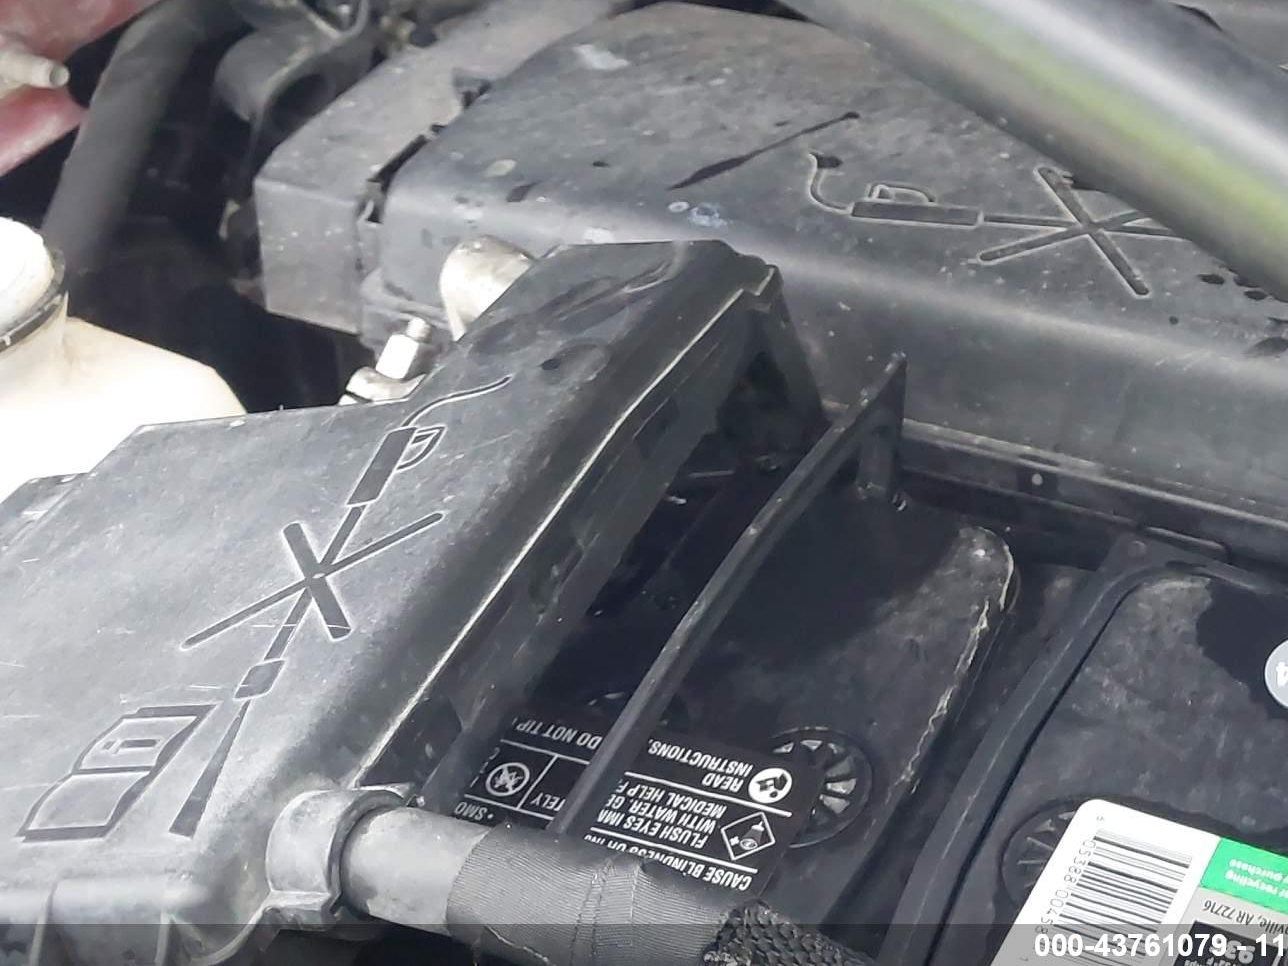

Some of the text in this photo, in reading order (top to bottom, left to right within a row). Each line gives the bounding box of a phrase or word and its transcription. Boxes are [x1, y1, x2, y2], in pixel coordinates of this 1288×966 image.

[544, 726, 576, 745] NOT
[578, 732, 603, 750] DO
[629, 781, 669, 804] HELP
[702, 772, 745, 793] READ
[670, 791, 727, 819] MEDICAL
[624, 814, 662, 838] EYES
[679, 812, 717, 834] WITH
[663, 825, 709, 849] FLUSH
[702, 865, 752, 891] CAUSE
[1202, 899, 1233, 922] 72716
[1234, 910, 1254, 924] AR
